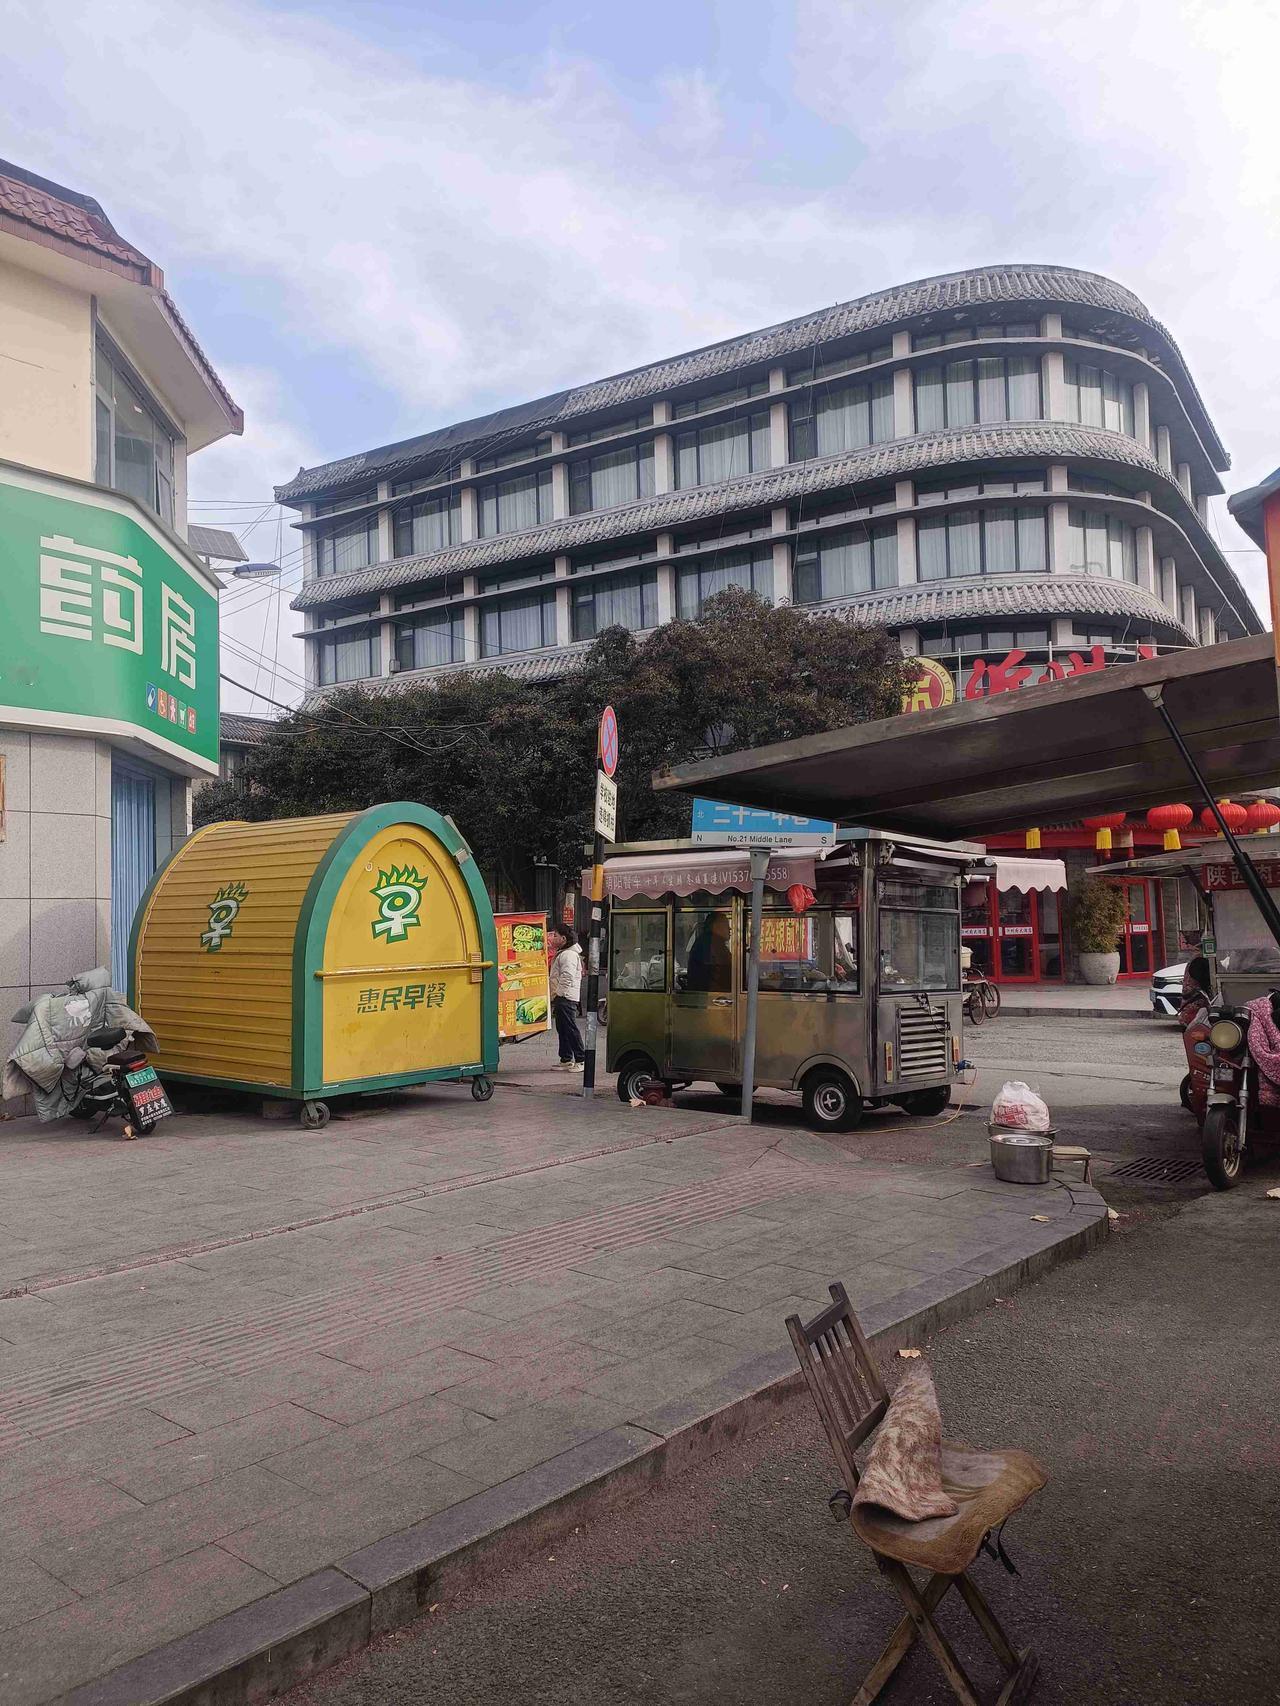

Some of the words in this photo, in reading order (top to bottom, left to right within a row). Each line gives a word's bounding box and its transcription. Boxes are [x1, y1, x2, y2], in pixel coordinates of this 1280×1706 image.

[39, 533, 197, 691] 药房
[696, 834, 703, 842] N
[727, 835, 747, 843] No.21
[749, 835, 773, 843] Middle
[774, 836, 793, 844] Lane
[820, 836, 828, 844] S
[1207, 864, 1280, 887] 陕西肉
[356, 982, 447, 1014] 惠民早餐
